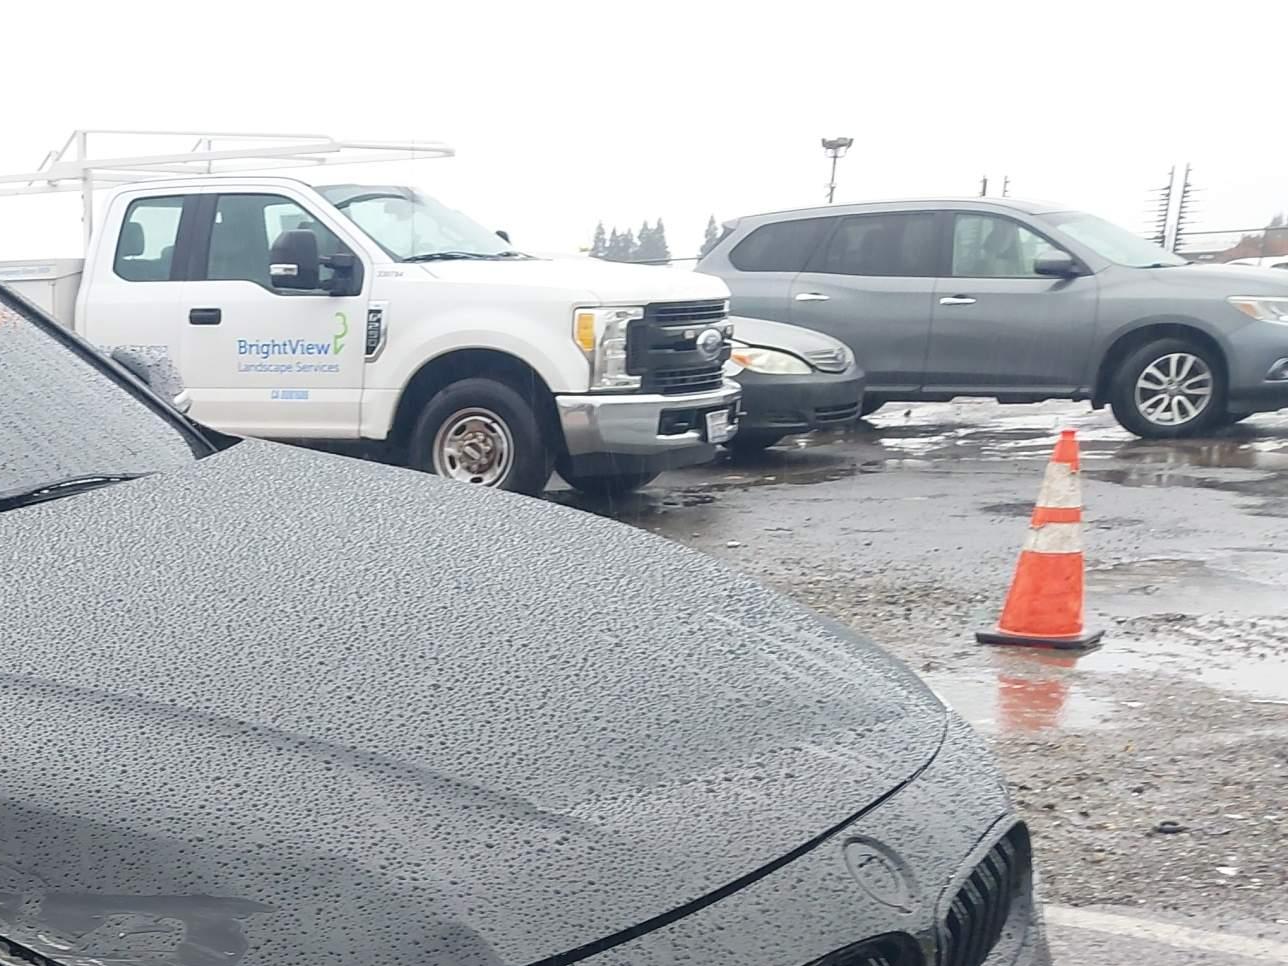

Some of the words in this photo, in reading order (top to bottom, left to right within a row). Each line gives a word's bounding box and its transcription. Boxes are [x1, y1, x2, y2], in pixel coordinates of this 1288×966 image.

[237, 339, 330, 359] BrightView
[238, 362, 294, 374] Landscape
[296, 362, 340, 373] Services
